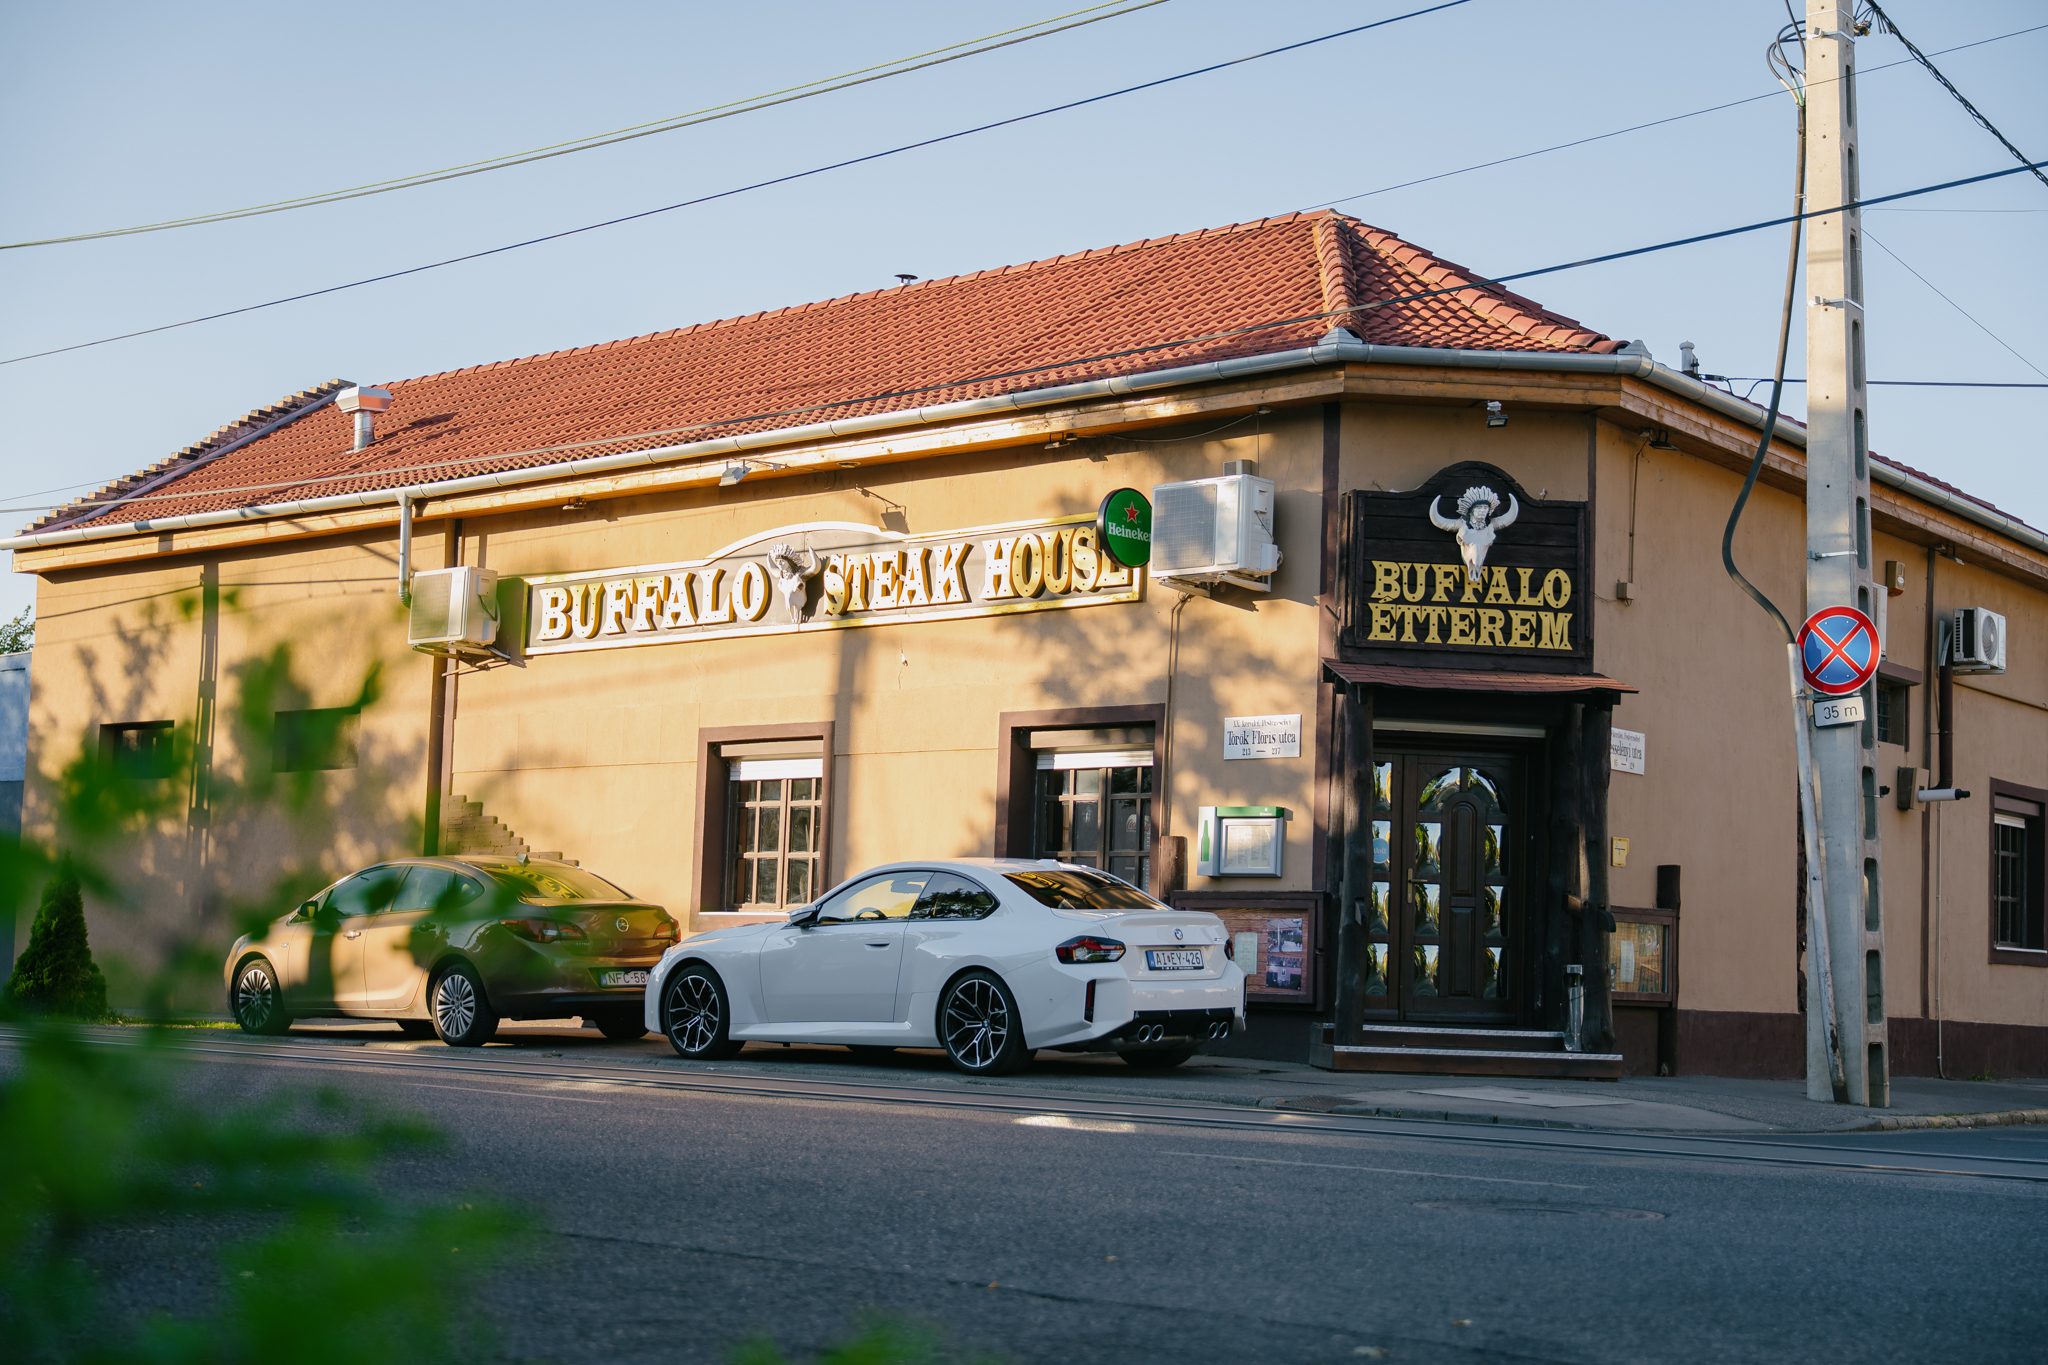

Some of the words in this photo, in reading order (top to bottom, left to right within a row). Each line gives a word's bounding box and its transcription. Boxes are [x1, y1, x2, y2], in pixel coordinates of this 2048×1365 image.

[1108, 521, 1151, 542] Heineke
[537, 562, 770, 640] BUFFALO
[823, 543, 973, 615] STEAK
[1370, 560, 1572, 609] BUFFALO
[1367, 596, 1573, 651] ÉTTEREM
[1823, 705, 1839, 720] 35
[1844, 705, 1857, 717] m
[1227, 730, 1249, 745] Török
[1252, 730, 1276, 745] Flóris
[1278, 729, 1296, 744] utca
[608, 972, 648, 984] NFC-58
